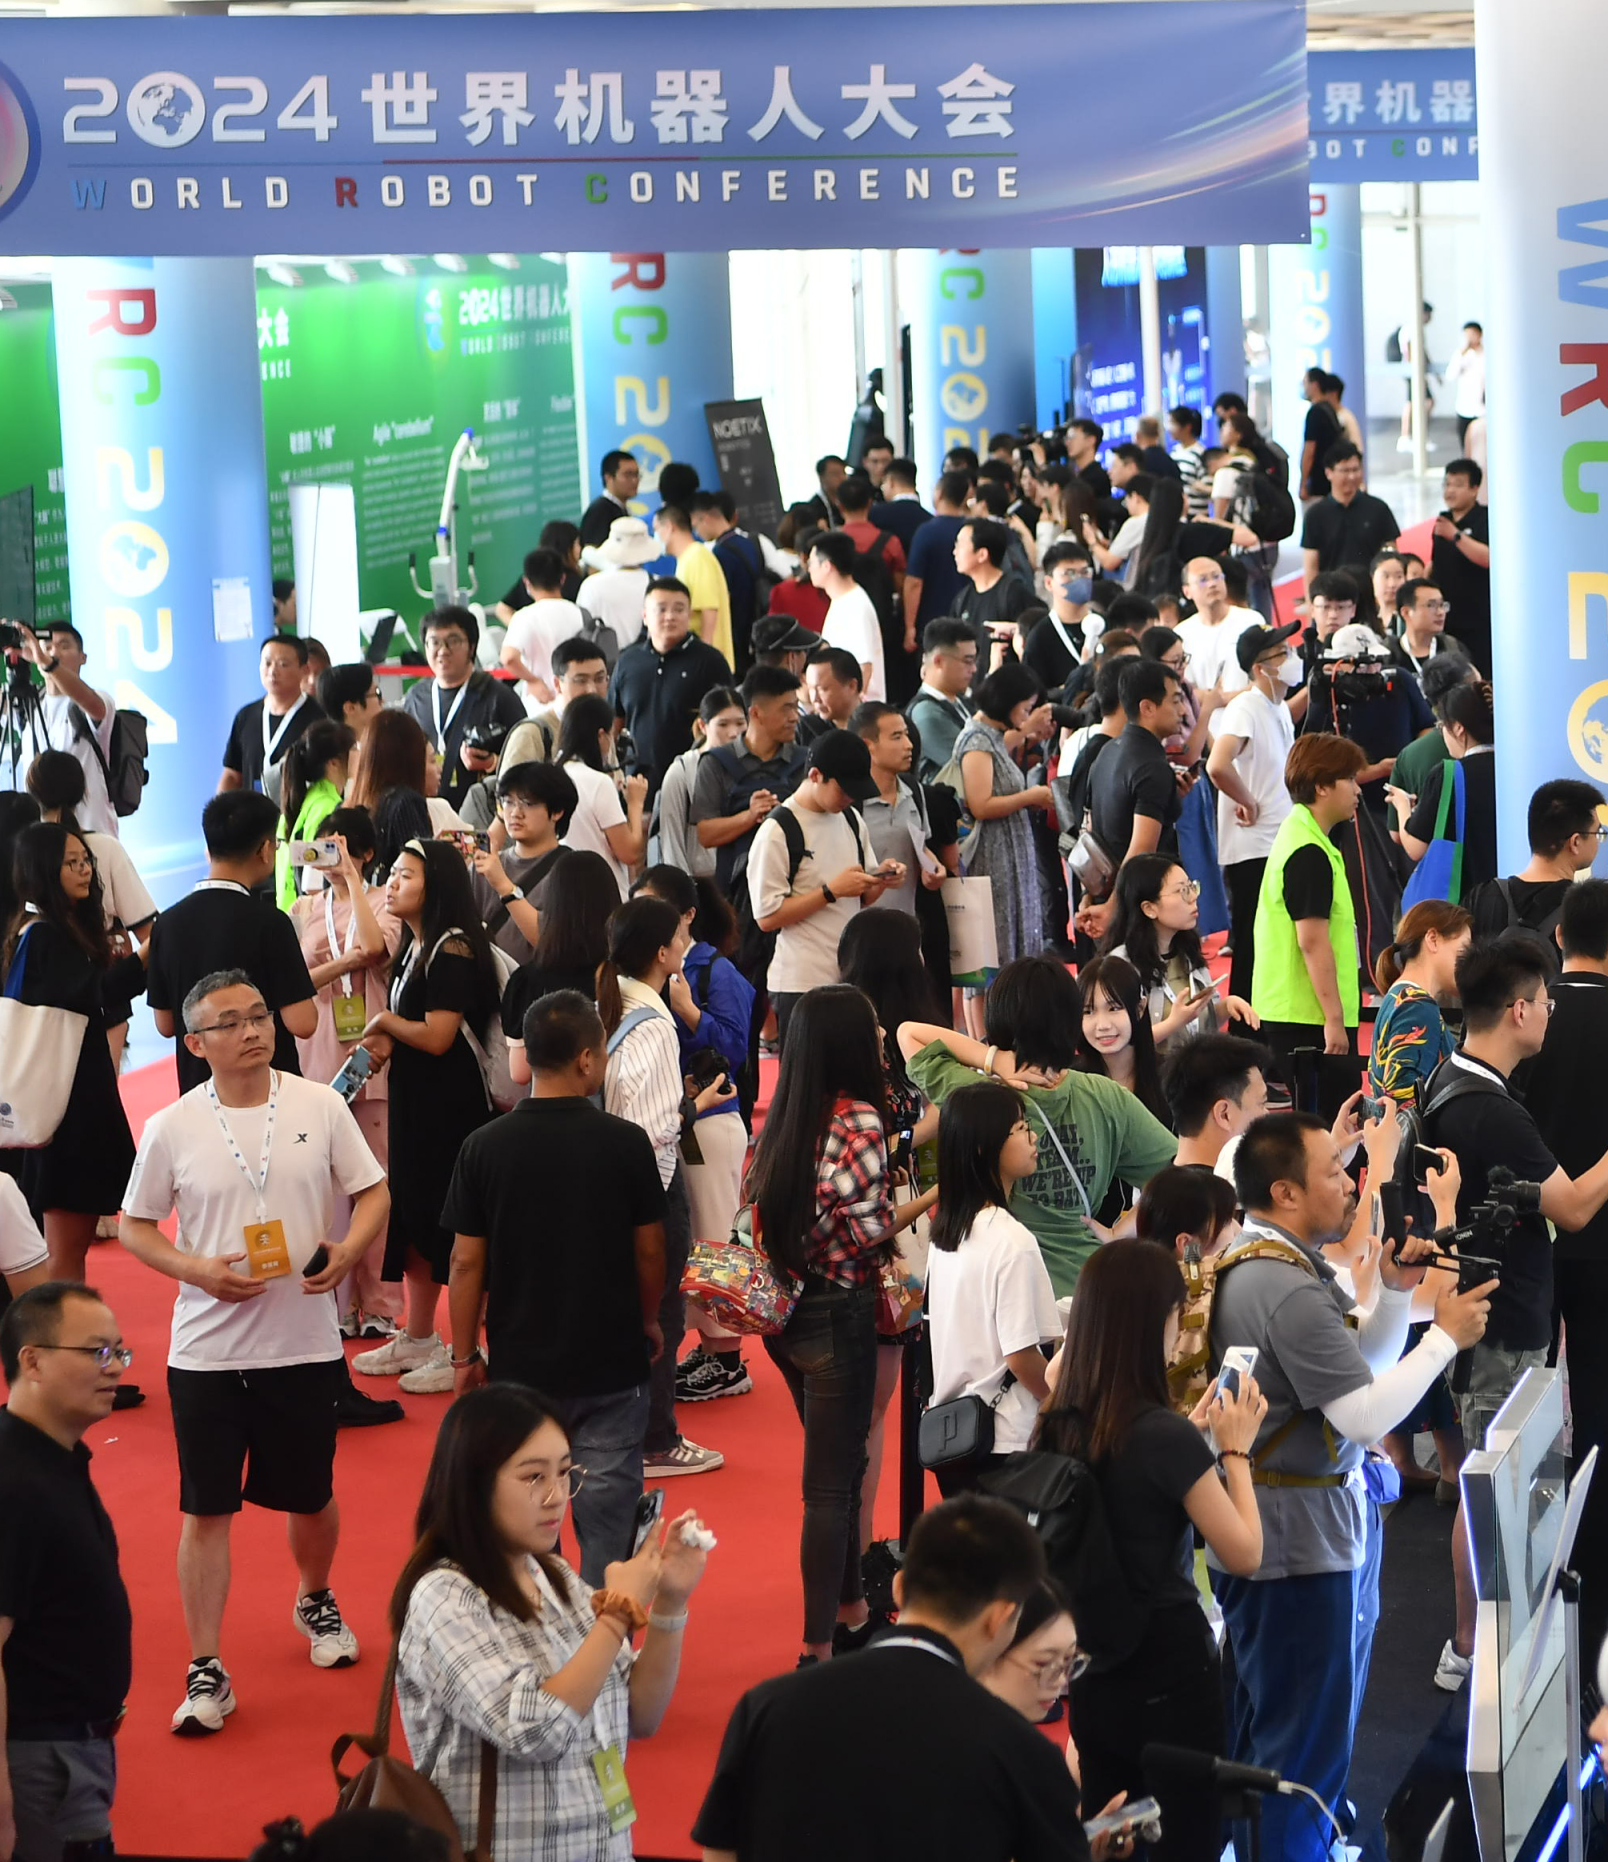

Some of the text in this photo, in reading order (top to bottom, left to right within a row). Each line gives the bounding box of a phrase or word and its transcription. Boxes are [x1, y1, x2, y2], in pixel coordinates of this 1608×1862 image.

[1308, 80, 1475, 125] 界机器
[72, 165, 1019, 210] WORLD ROBOT CONFERENCE
[87, 257, 162, 406] RC
